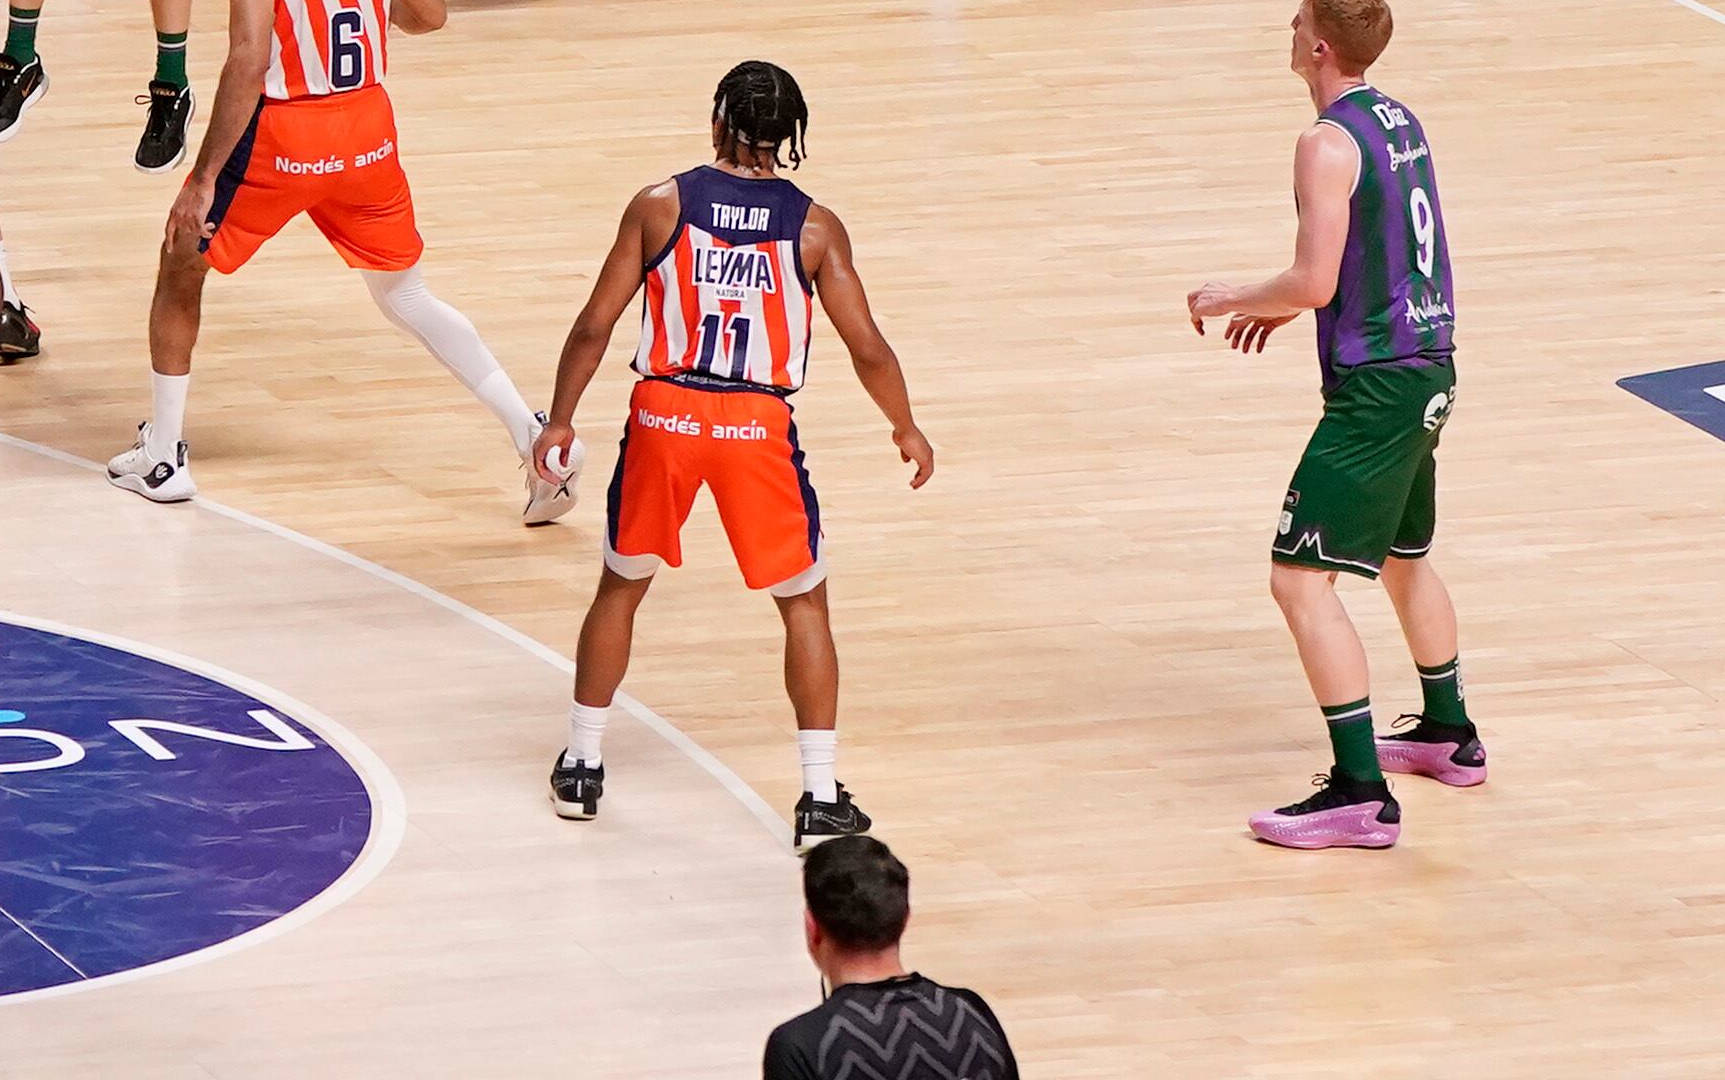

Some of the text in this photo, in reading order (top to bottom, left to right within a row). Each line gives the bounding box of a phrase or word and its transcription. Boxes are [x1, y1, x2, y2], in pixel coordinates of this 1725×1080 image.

[331, 10, 362, 89] 6
[276, 138, 394, 175] Nordés ancín
[711, 202, 770, 232] TAYLOR
[1409, 187, 1435, 279] 9
[694, 248, 774, 291] LEYMA
[715, 288, 745, 299] NATURA
[699, 314, 751, 380] 11
[638, 409, 767, 440] Nordés ancín
